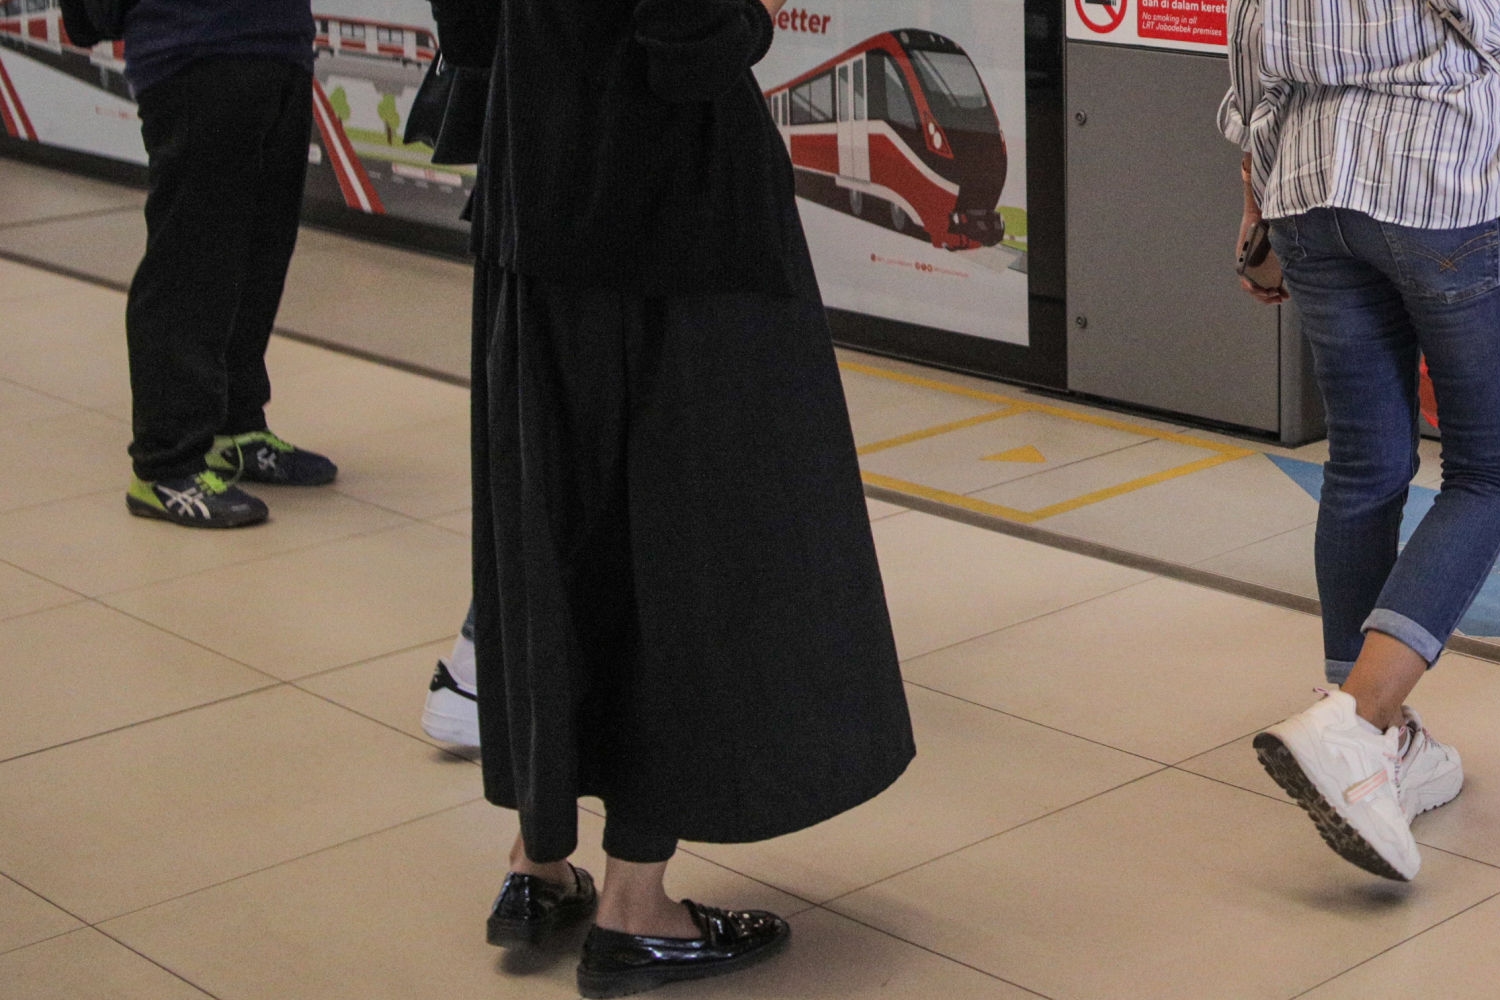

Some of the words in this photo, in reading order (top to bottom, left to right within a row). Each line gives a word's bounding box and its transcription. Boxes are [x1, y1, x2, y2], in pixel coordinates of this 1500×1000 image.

[1172, 0, 1199, 10] dalam
[773, 7, 831, 34] etter
[1142, 12, 1151, 20] No
[1153, 14, 1179, 24] smoking
[1142, 21, 1155, 29] LRT
[1192, 27, 1222, 35] premises
